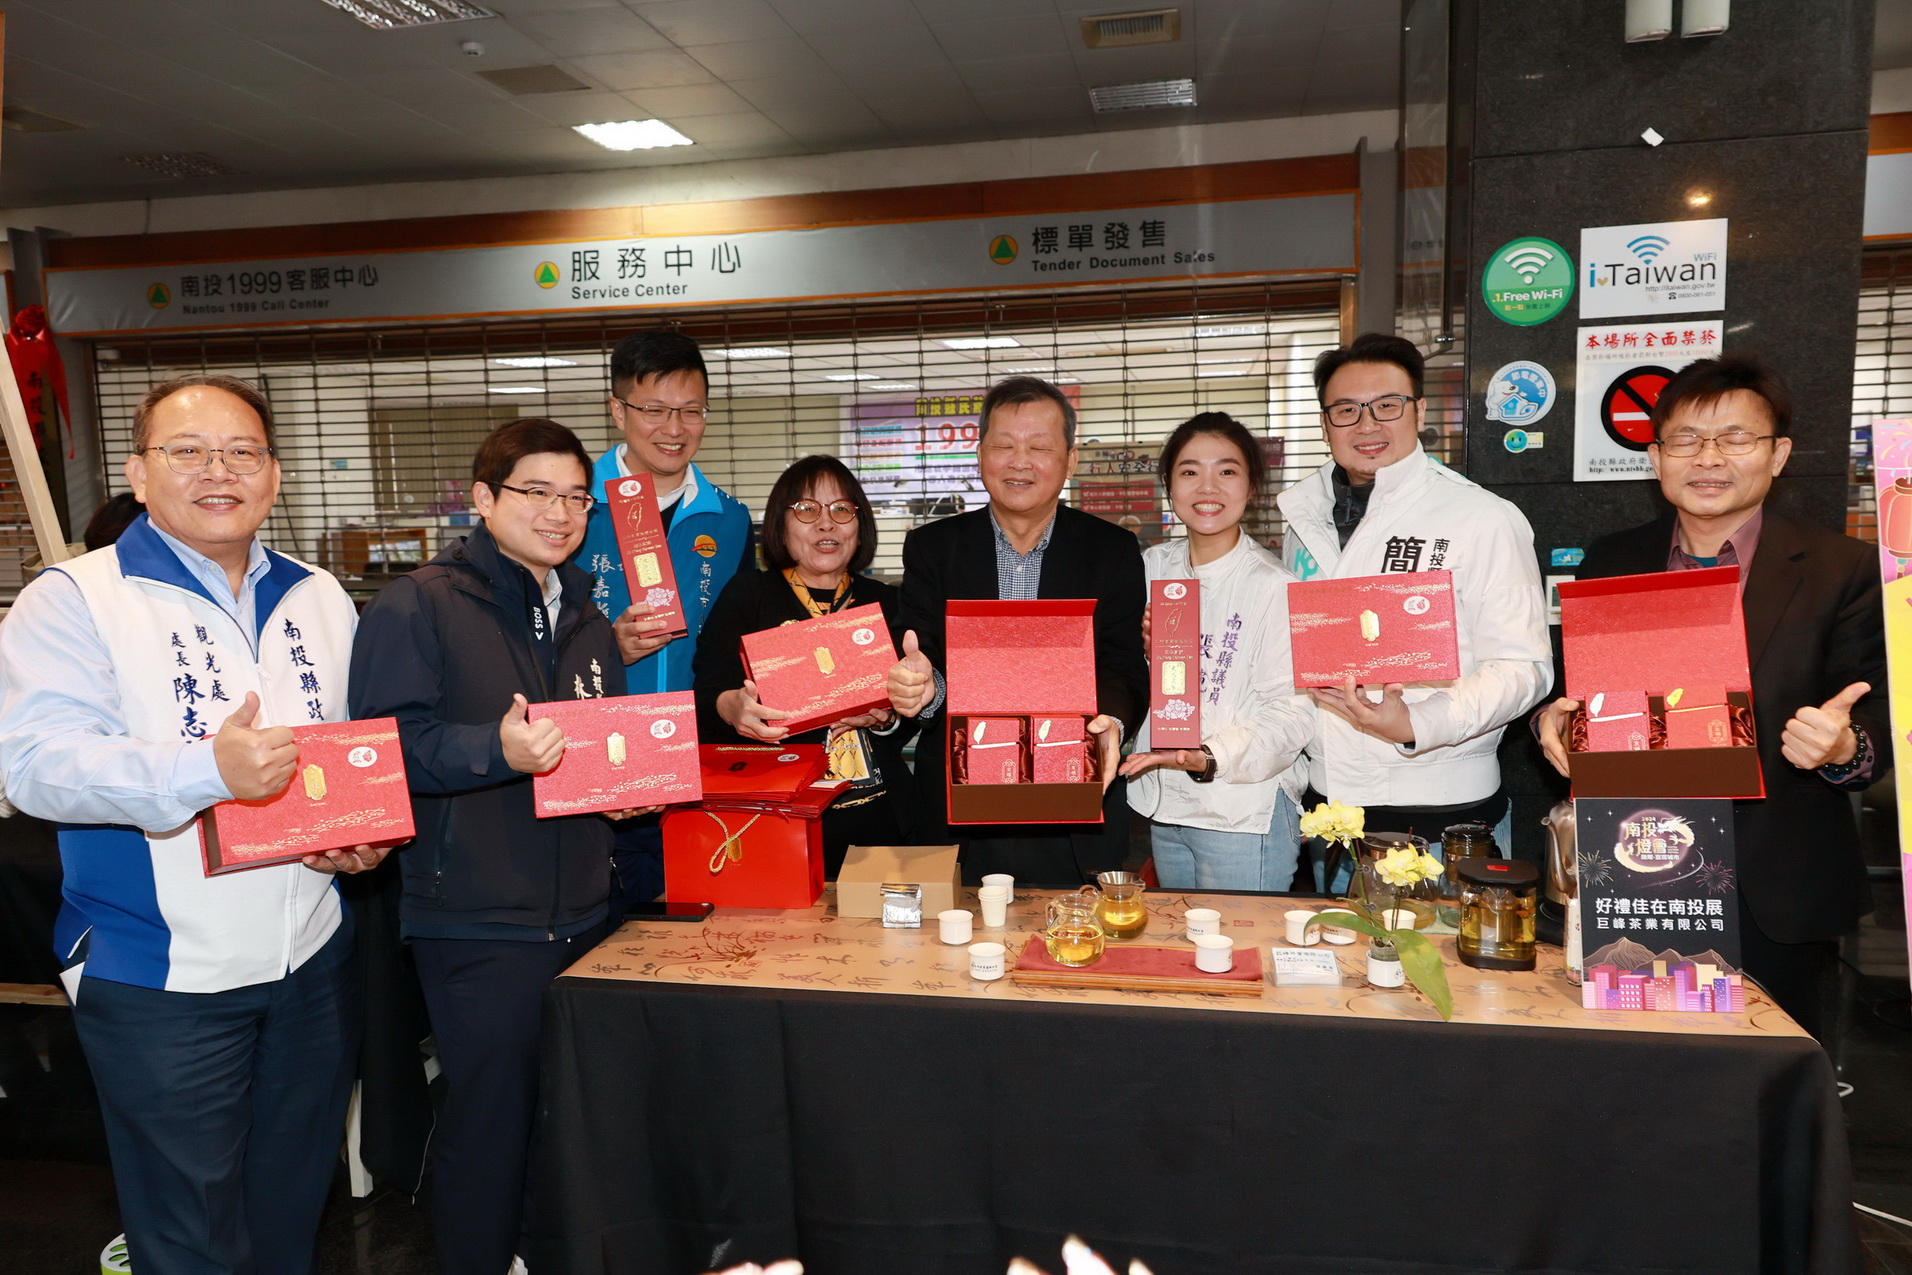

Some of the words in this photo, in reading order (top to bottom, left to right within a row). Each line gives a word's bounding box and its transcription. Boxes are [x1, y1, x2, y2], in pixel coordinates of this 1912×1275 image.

[1031, 220, 1166, 255] 標單發售
[571, 242, 741, 282] 服務中心
[1032, 260, 1082, 271] Tender
[1090, 253, 1166, 268] Document
[1173, 250, 1216, 264] Sales
[1694, 252, 1717, 261] WiFi
[180, 264, 379, 297] 南投1999客服中心
[572, 285, 631, 299] Service
[635, 283, 689, 297] Center
[1531, 288, 1563, 300] Wi-Fi
[183, 303, 225, 315] Nantou
[230, 301, 257, 313] 1999
[261, 299, 285, 311] Call
[289, 298, 330, 311] Center
[1585, 329, 1717, 349] 本場所全面禁菸
[1589, 457, 1653, 466] 南投縣政府衛
[533, 606, 544, 629] BOSS
[194, 624, 231, 702] 觀光處
[1207, 612, 1242, 706] 南投縣議員
[1624, 822, 1658, 840] 南投
[1595, 897, 1724, 916] 好禮佳在南投展
[1596, 917, 1724, 932] 巨峰茶業有限公司
